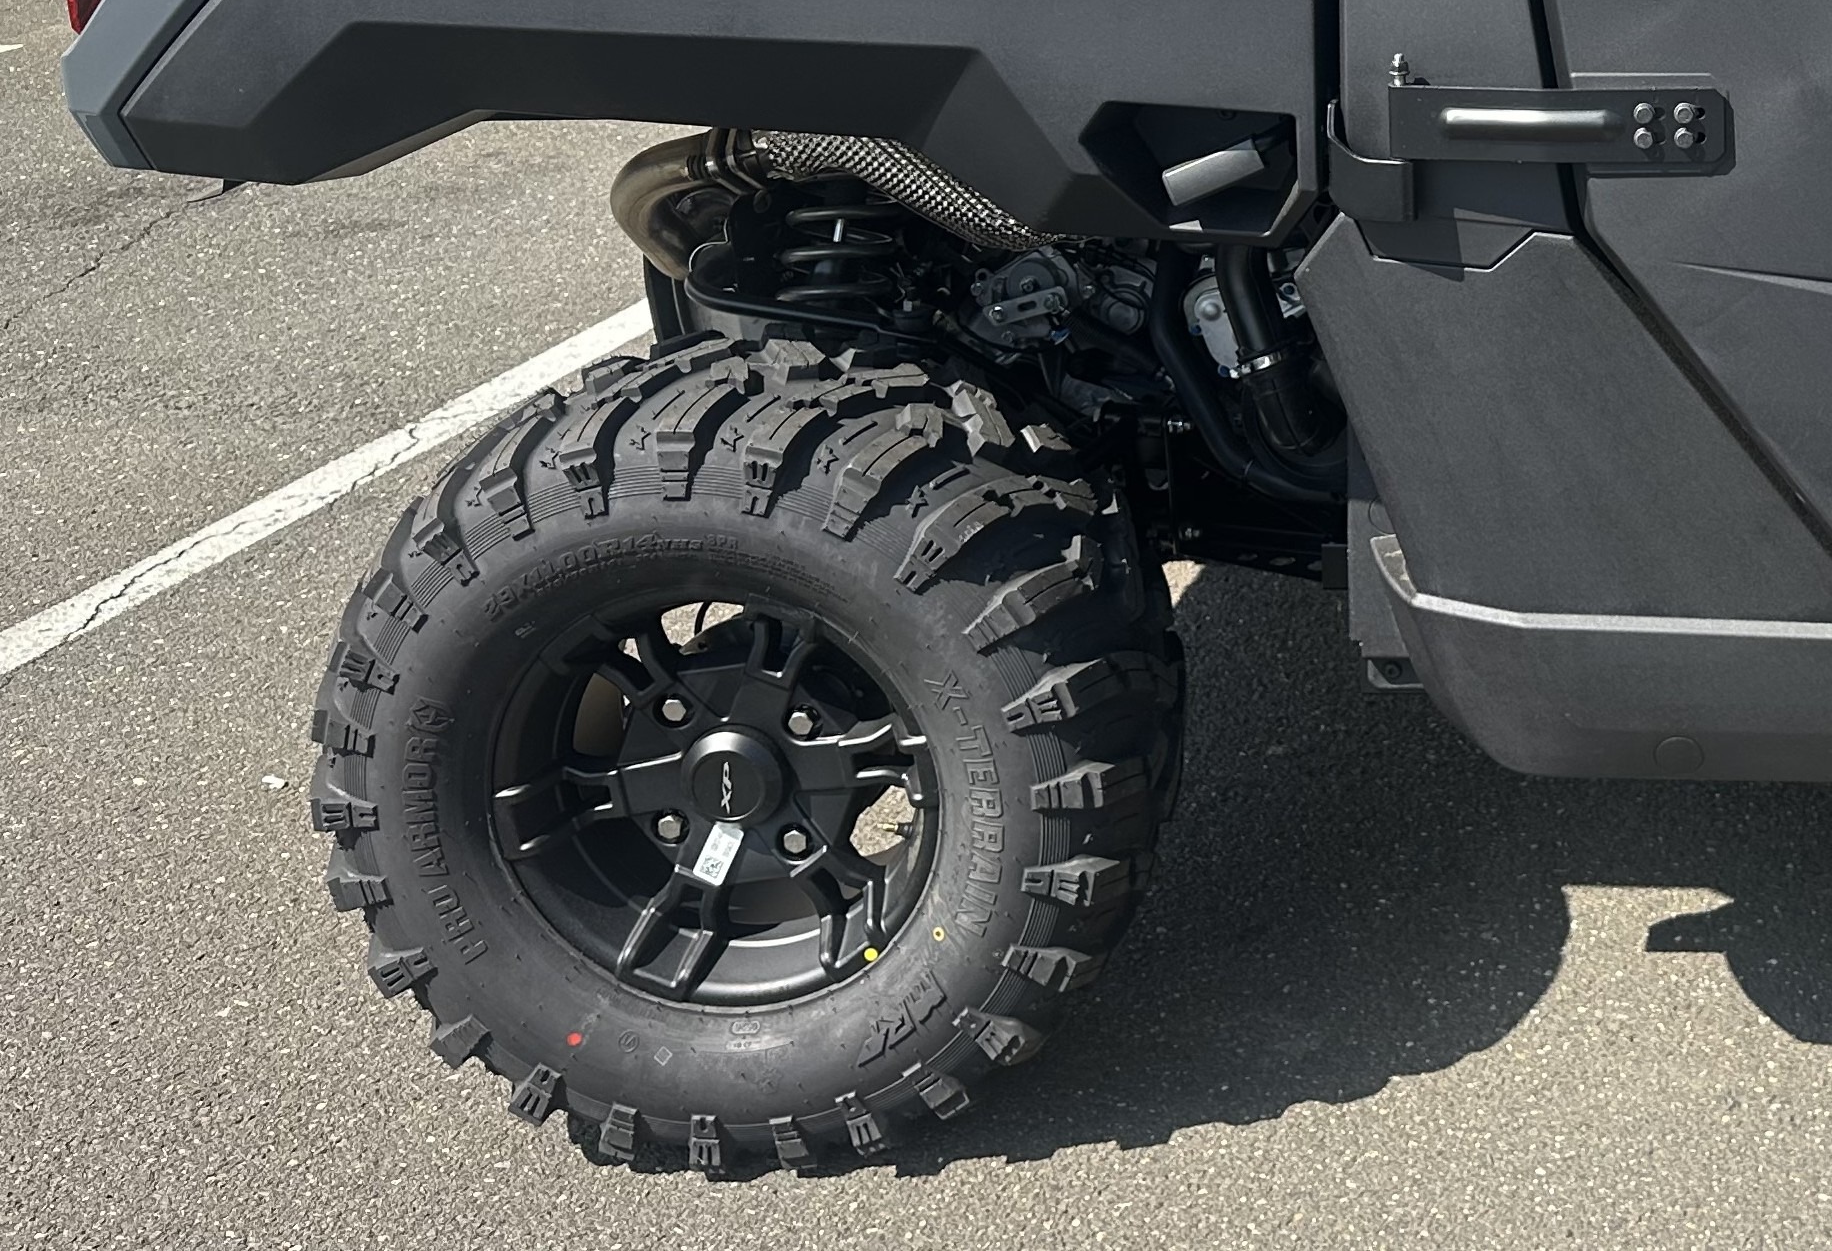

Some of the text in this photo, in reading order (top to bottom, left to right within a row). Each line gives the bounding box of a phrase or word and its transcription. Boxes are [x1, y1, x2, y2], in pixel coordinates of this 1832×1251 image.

[400, 737, 489, 966] PRO ARMOR
[720, 761, 733, 815] XP
[924, 669, 1005, 937] X-TERRAIN
